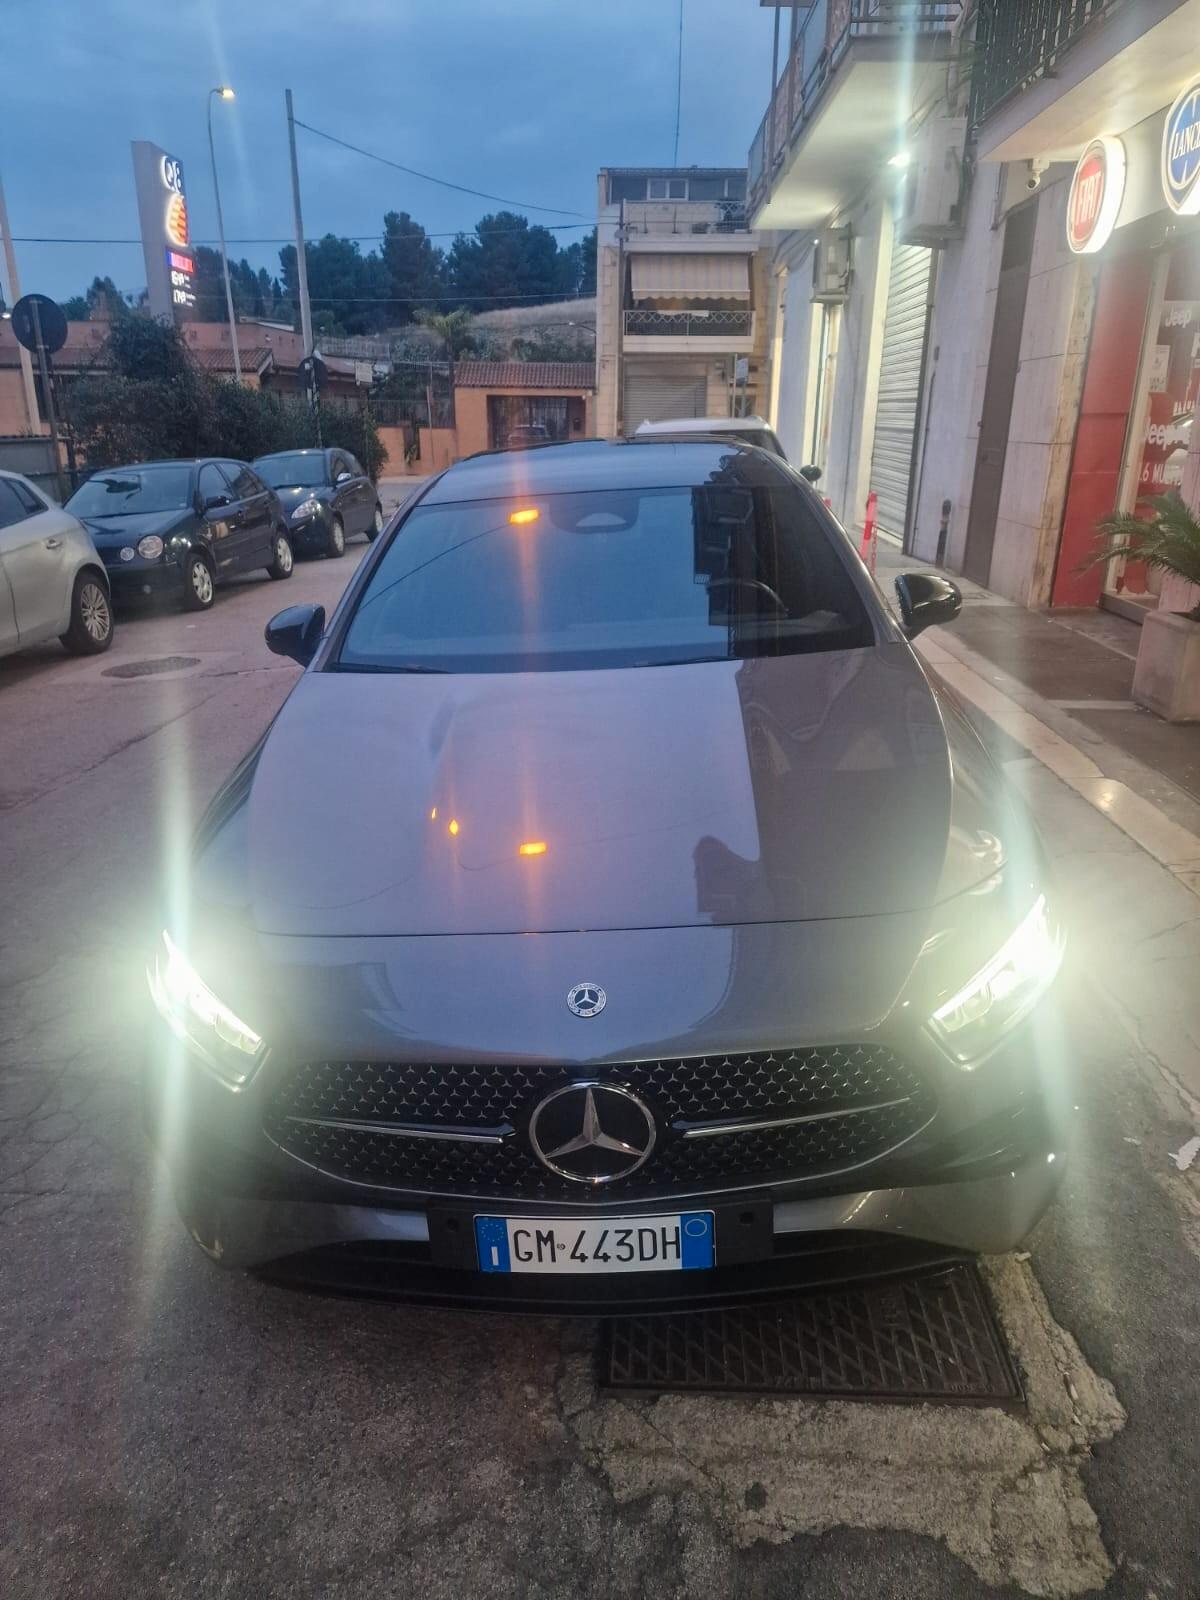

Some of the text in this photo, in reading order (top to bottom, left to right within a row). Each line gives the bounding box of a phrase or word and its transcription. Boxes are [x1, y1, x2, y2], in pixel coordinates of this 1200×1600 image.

[1075, 170, 1102, 226] FIAT
[1165, 304, 1192, 328] Jeep
[513, 1229, 556, 1263] GM
[570, 1226, 681, 1263] 443DH
